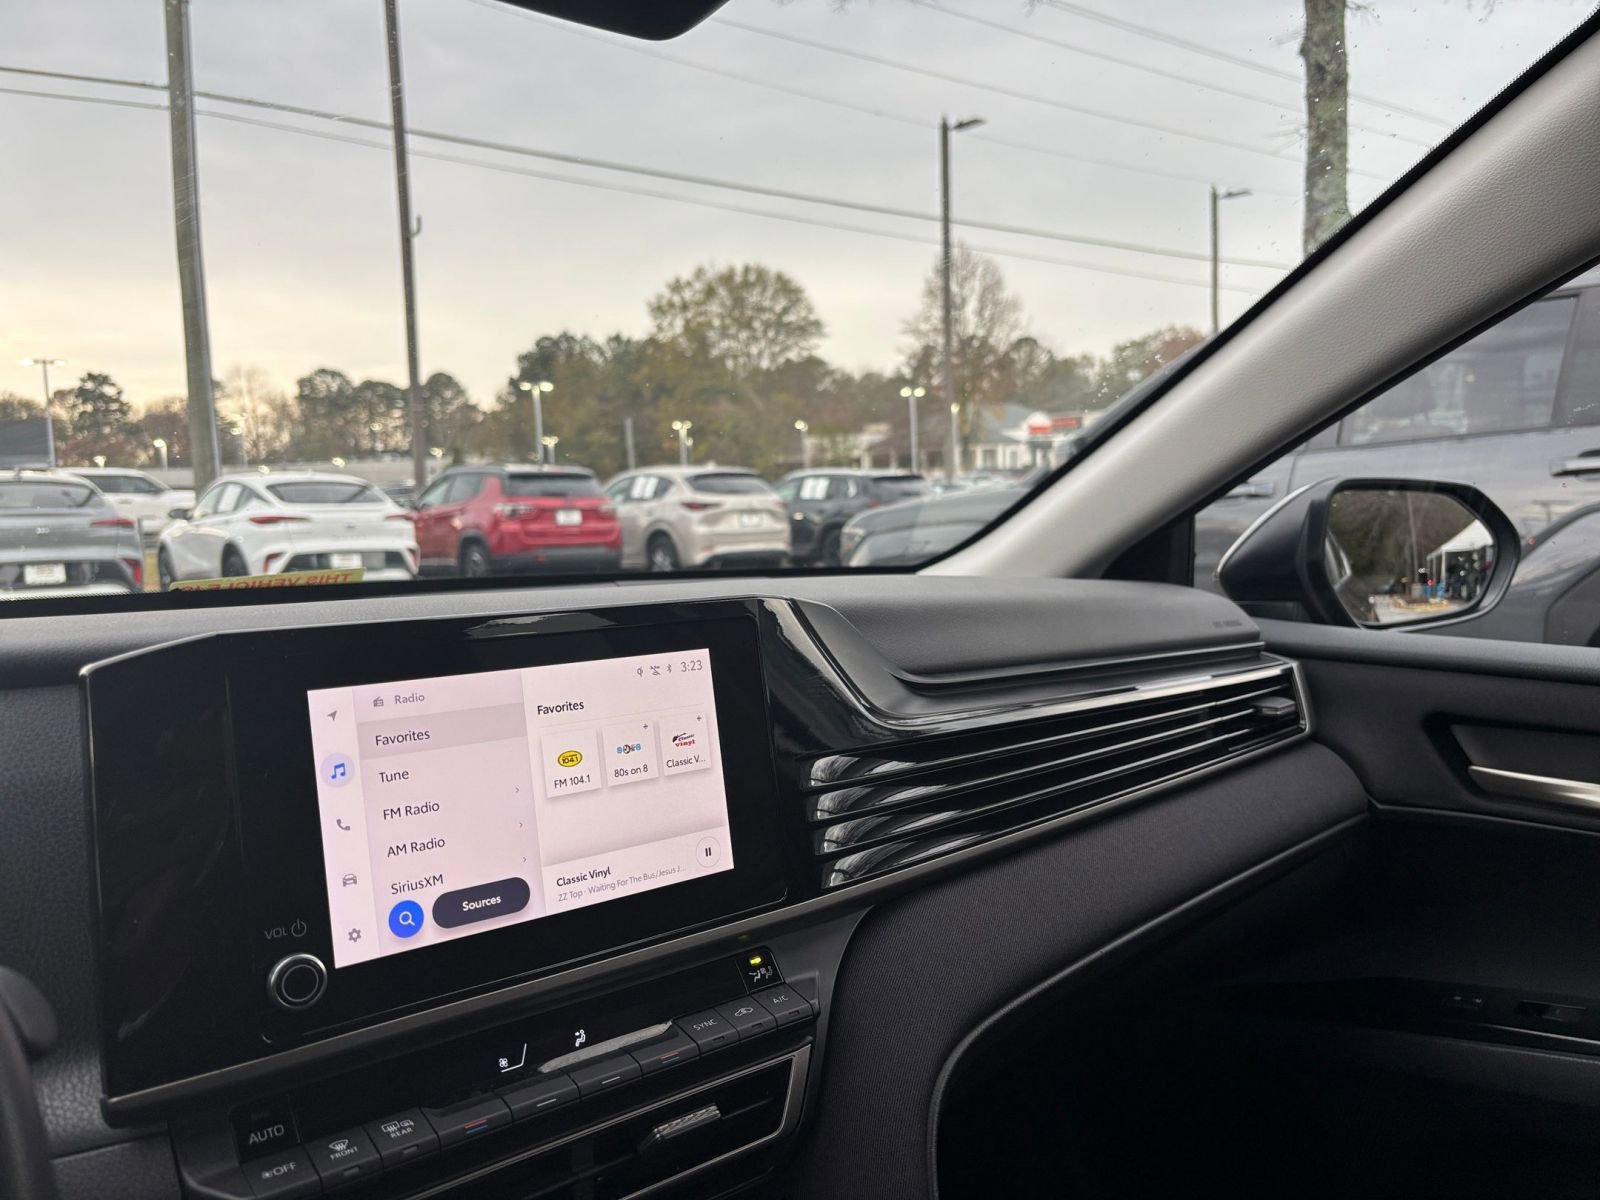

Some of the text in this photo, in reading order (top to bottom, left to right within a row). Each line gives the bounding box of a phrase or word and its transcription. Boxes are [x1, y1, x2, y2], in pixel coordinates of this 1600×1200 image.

[680, 659, 703, 673] 3:23
[394, 692, 425, 705] Radio
[537, 701, 585, 715] Favorites
[375, 728, 431, 746] Favorites
[666, 756, 693, 768] Classic
[378, 768, 410, 783] Tune
[614, 764, 649, 778] 80s on 8
[554, 774, 591, 789] FM 104.1
[383, 801, 440, 820] FM Radio
[387, 837, 446, 858] AM Radio
[556, 866, 612, 887] Classic Vinyl
[391, 874, 444, 895] SiriusXM
[558, 892, 568, 902] ZZ
[569, 889, 583, 900] Top
[588, 881, 616, 895] Waiting
[617, 878, 629, 888] For
[630, 874, 643, 885] The
[462, 895, 502, 912] Sources
[264, 927, 288, 940] VOL
[773, 994, 788, 1004] A/C
[693, 1018, 718, 1031] SYNC
[249, 1124, 285, 1144] AUTO
[390, 1127, 414, 1139] REAR
[330, 1146, 358, 1160] FRONT
[273, 1162, 297, 1176] OFF
